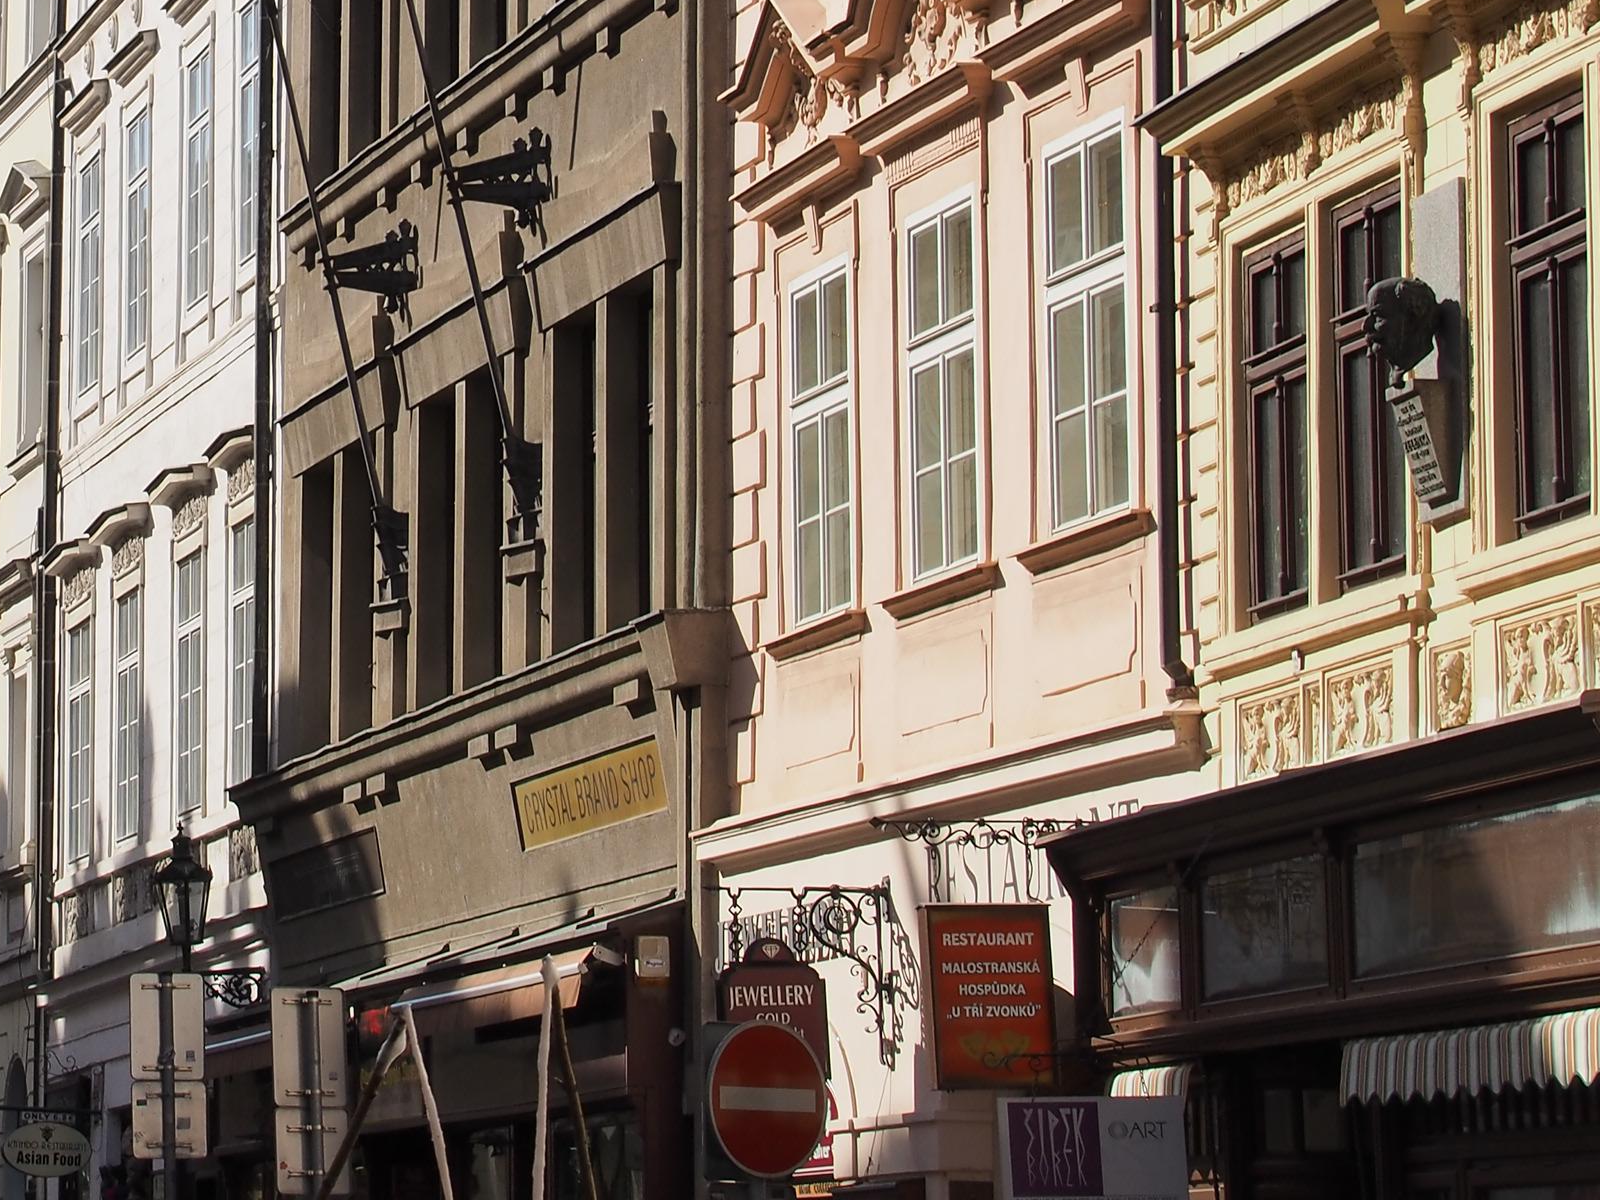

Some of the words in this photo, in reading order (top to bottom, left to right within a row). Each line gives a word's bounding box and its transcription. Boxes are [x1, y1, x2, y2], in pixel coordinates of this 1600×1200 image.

[524, 783, 576, 834] CRYSTAL
[574, 767, 619, 819] BRAND
[620, 754, 656, 806] SHOP
[942, 932, 1034, 946] RESTAURANT
[942, 958, 1041, 974] MALOSTRANSKÁ
[959, 980, 1026, 996] HOSPŮDKA
[729, 984, 814, 1010] JEWELLERY
[963, 1003, 983, 1018] TŘÍ
[16, 1150, 50, 1165] Asian
[53, 1152, 81, 1167] Food
